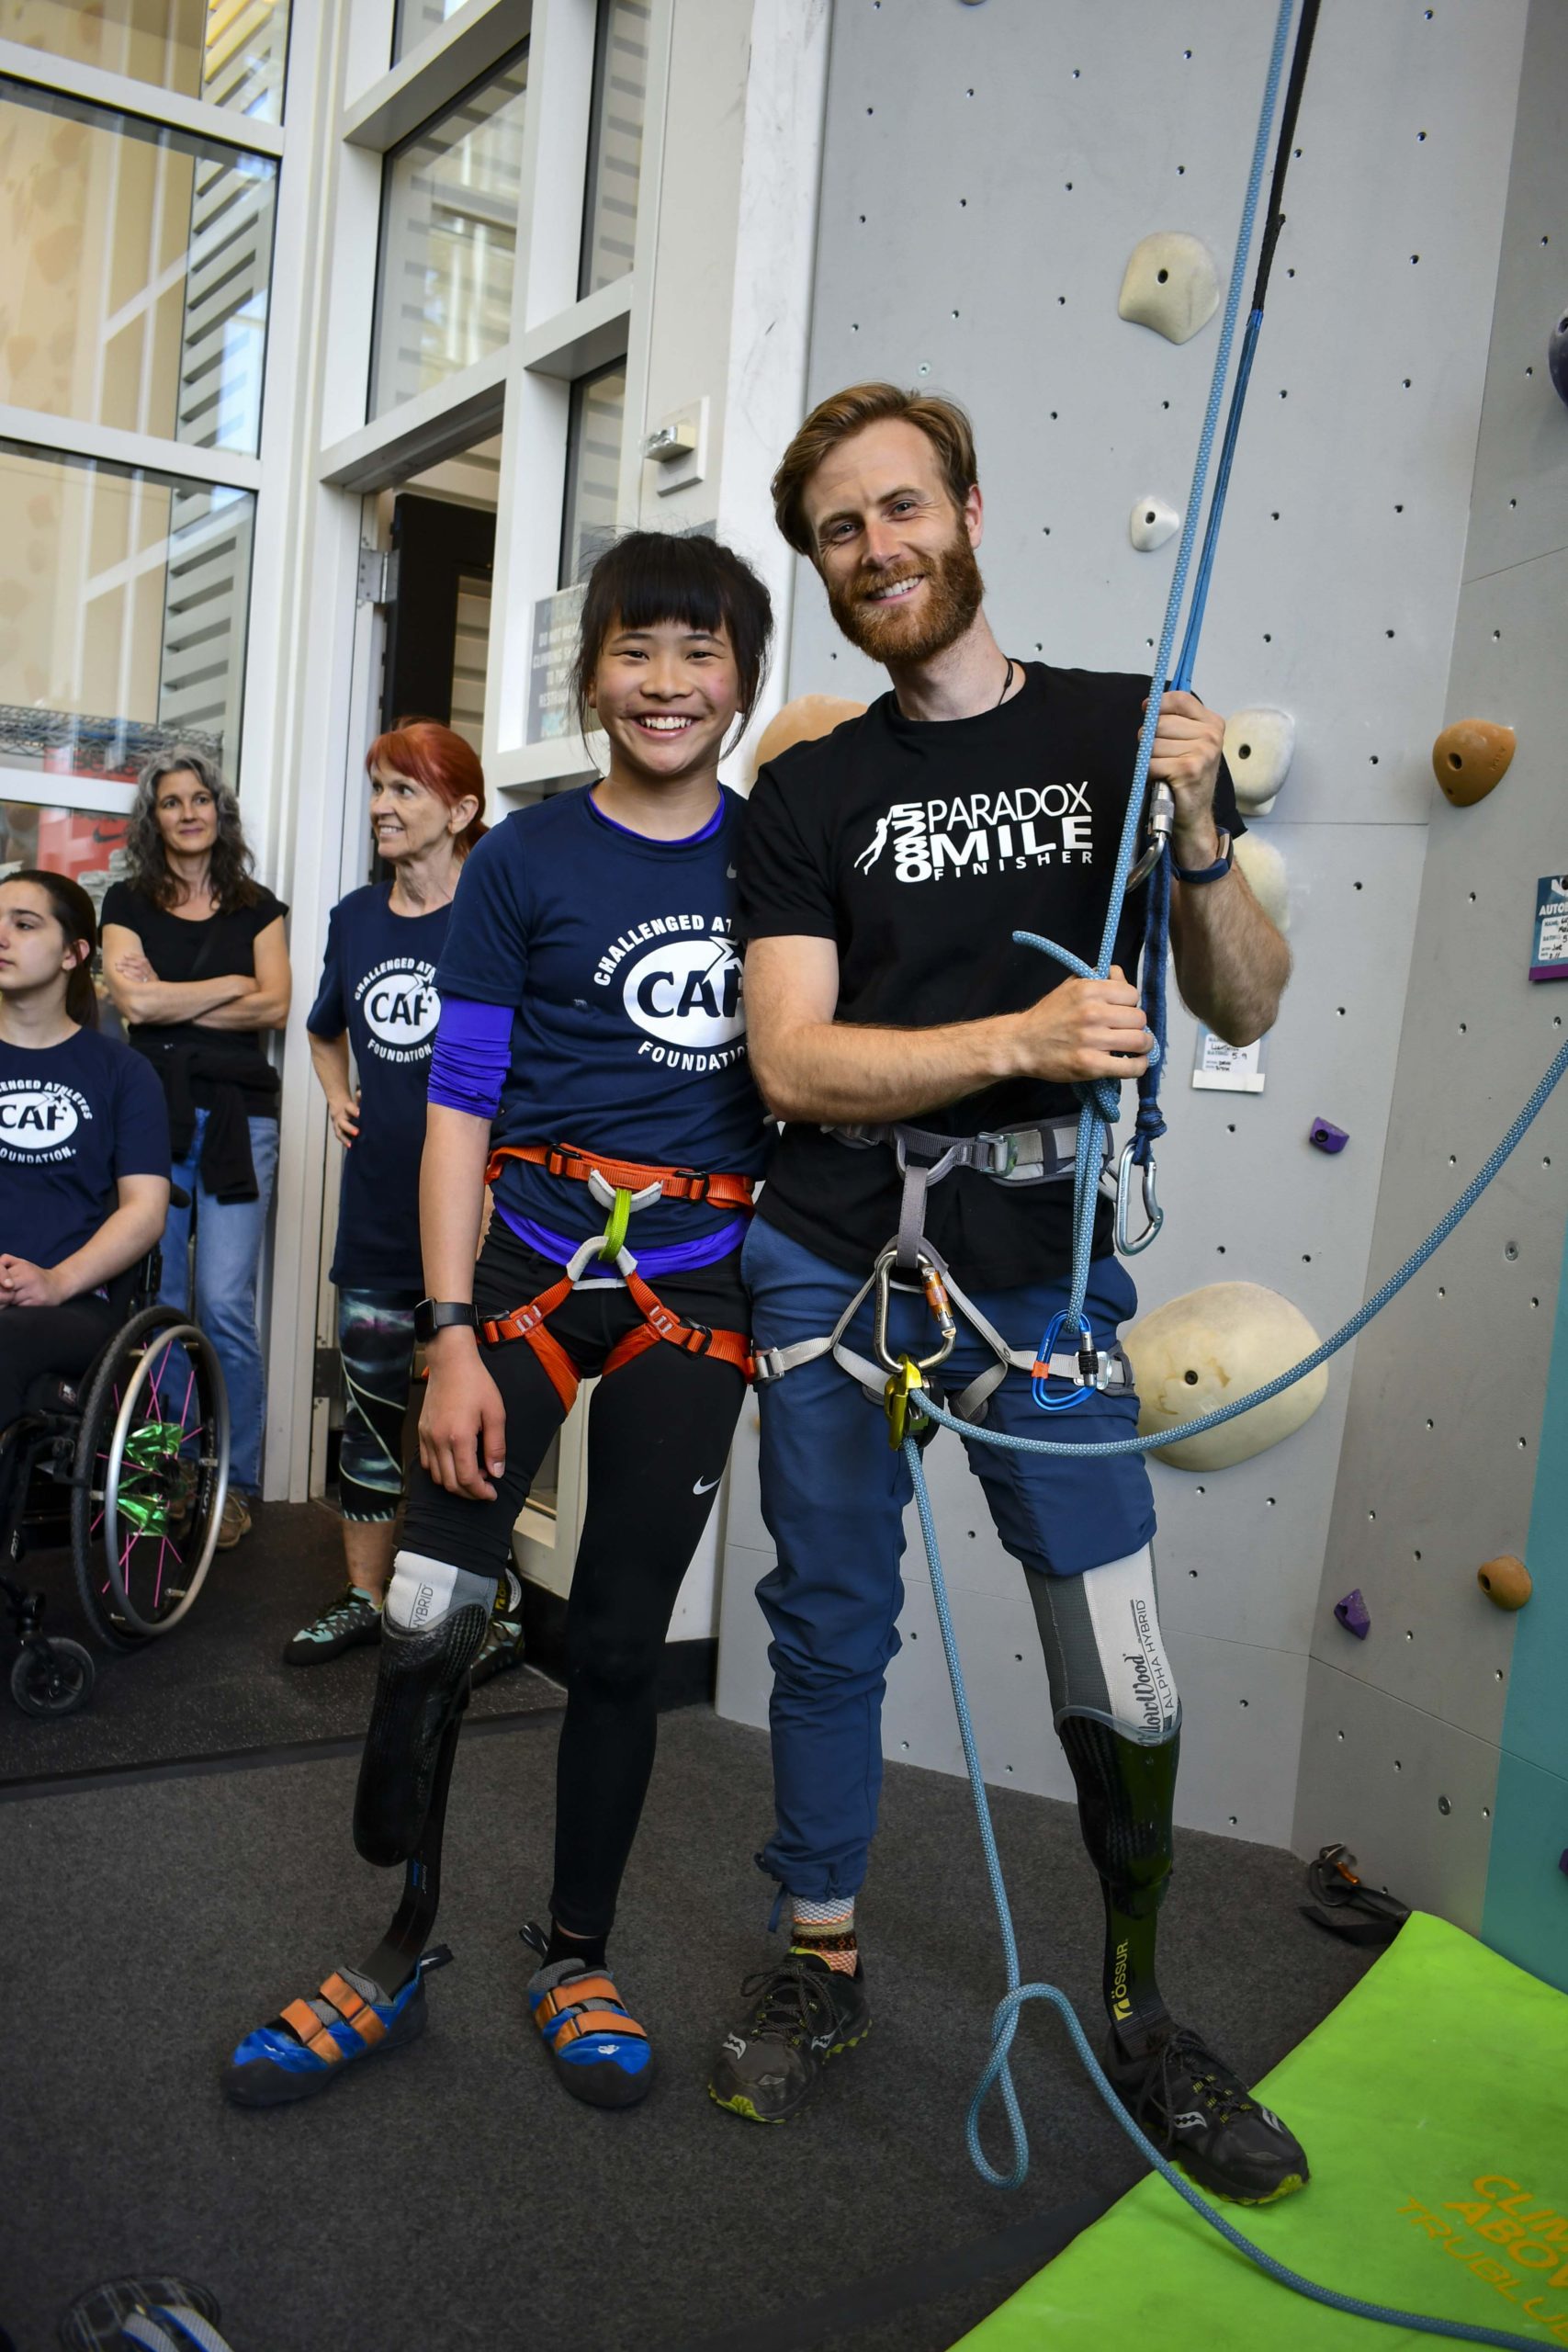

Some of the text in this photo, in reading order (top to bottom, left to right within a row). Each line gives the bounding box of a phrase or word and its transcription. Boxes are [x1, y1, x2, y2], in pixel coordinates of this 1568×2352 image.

[927, 781, 1092, 833] PARADOX
[930, 815, 1093, 868] MILE
[933, 851, 1093, 881] FINISHER
[593, 914, 705, 987] CHALLENGED
[355, 957, 415, 1001] CHALLENGED
[371, 992, 433, 1026] CAF
[367, 1038, 433, 1062] FOUNDATION
[637, 1040, 749, 1072] FOUNDATIO
[0, 1146, 72, 1164] OUNDATION
[1136, 1600, 1175, 1709] ALPHA HYBRID
[1472, 2175, 1568, 2252] CLIM
